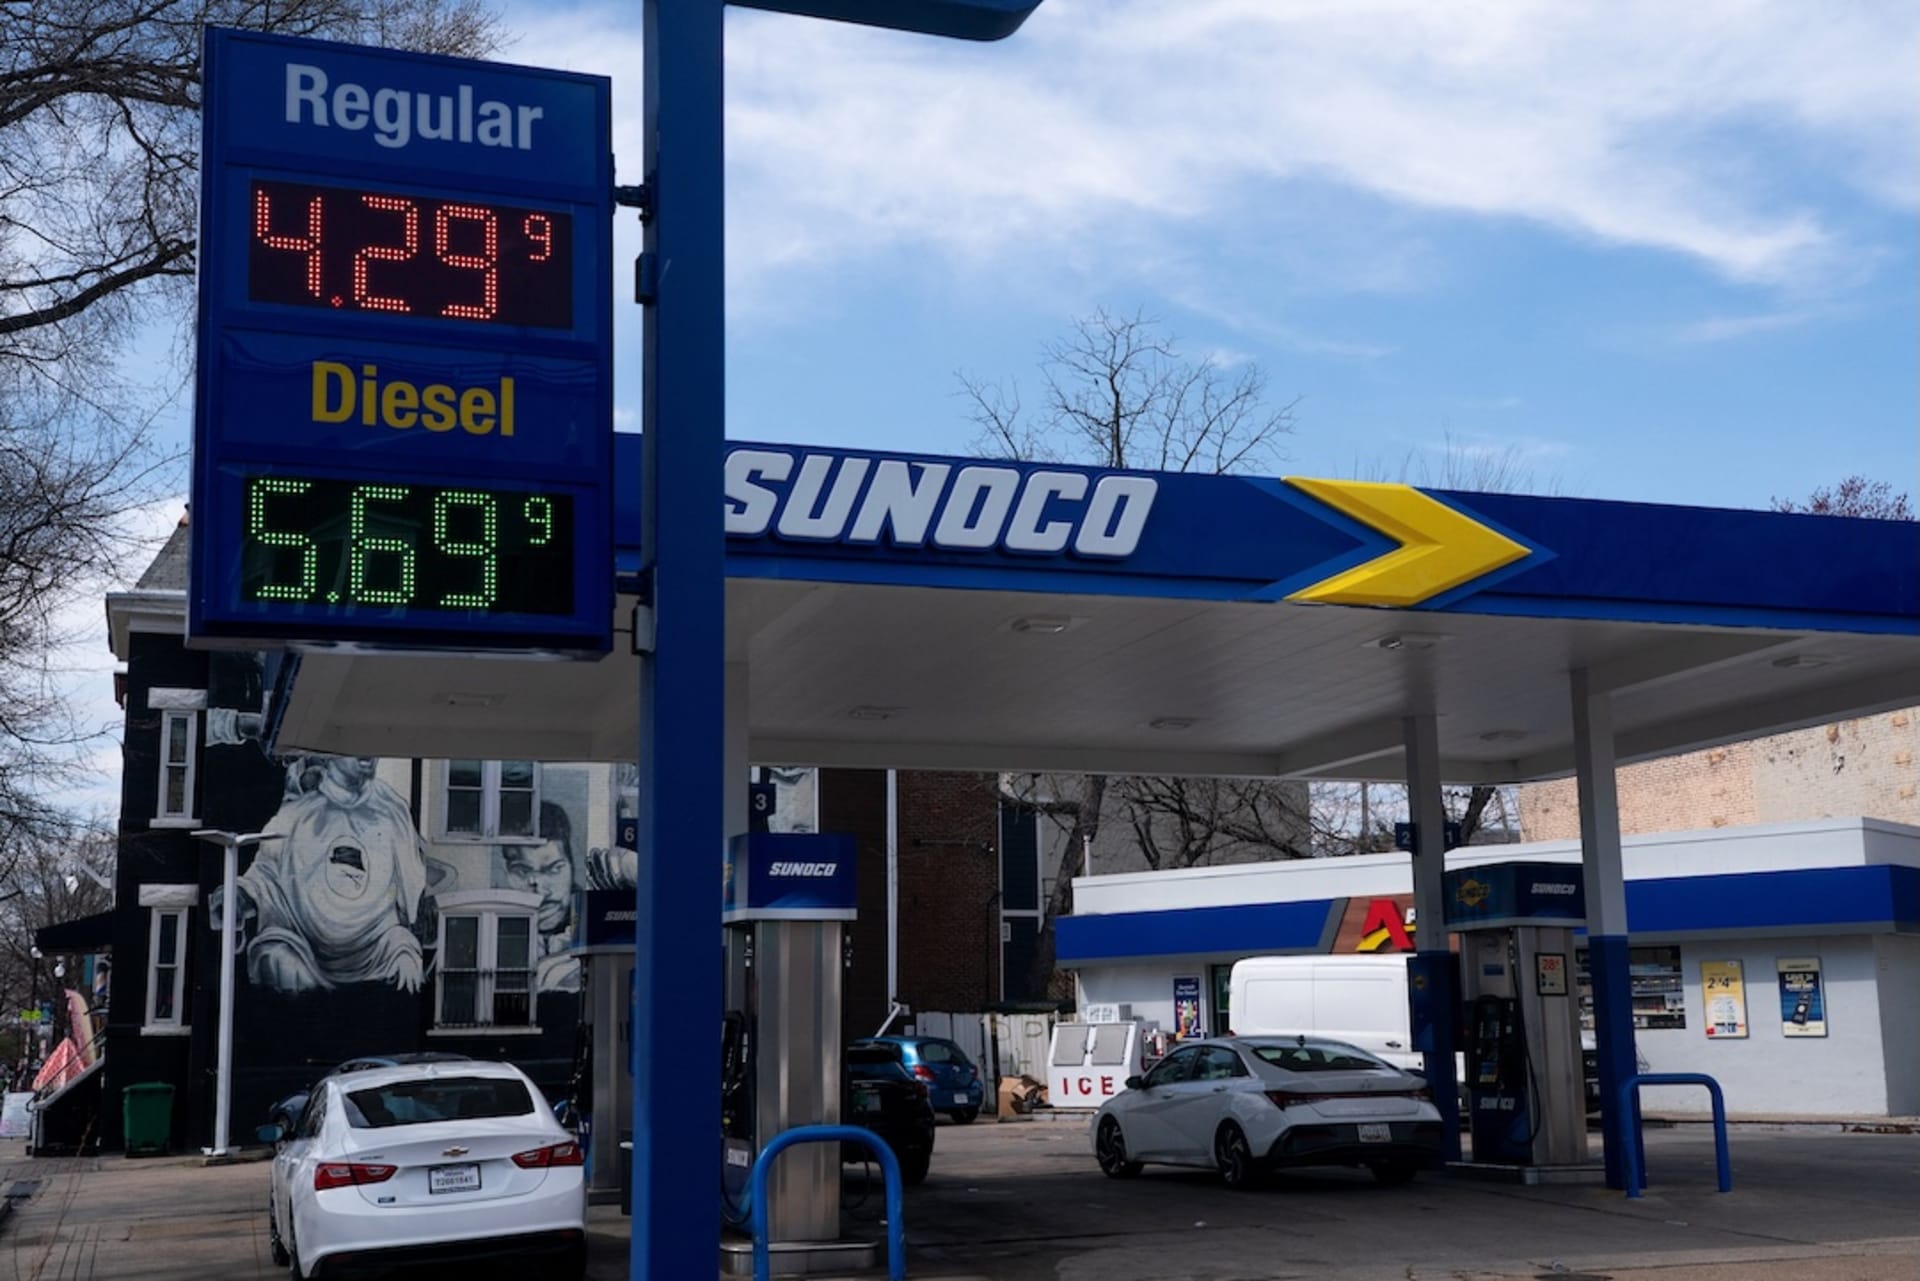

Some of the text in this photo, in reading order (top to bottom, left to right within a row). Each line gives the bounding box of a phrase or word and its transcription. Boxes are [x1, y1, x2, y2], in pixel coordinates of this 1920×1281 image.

[285, 63, 543, 149] Regular
[257, 189, 552, 319] 4.29 9
[311, 360, 515, 436] Diesel
[724, 449, 1158, 556] SUNOCO
[250, 478, 552, 607] 5.69 9
[755, 793, 767, 810] 3
[624, 827, 634, 843] 6
[1401, 832, 1411, 845] 2
[1448, 832, 1456, 844] 1
[769, 862, 837, 876] SUNOCO
[1531, 882, 1576, 895] SUNOCO
[1062, 1076, 1115, 1095] ICE
